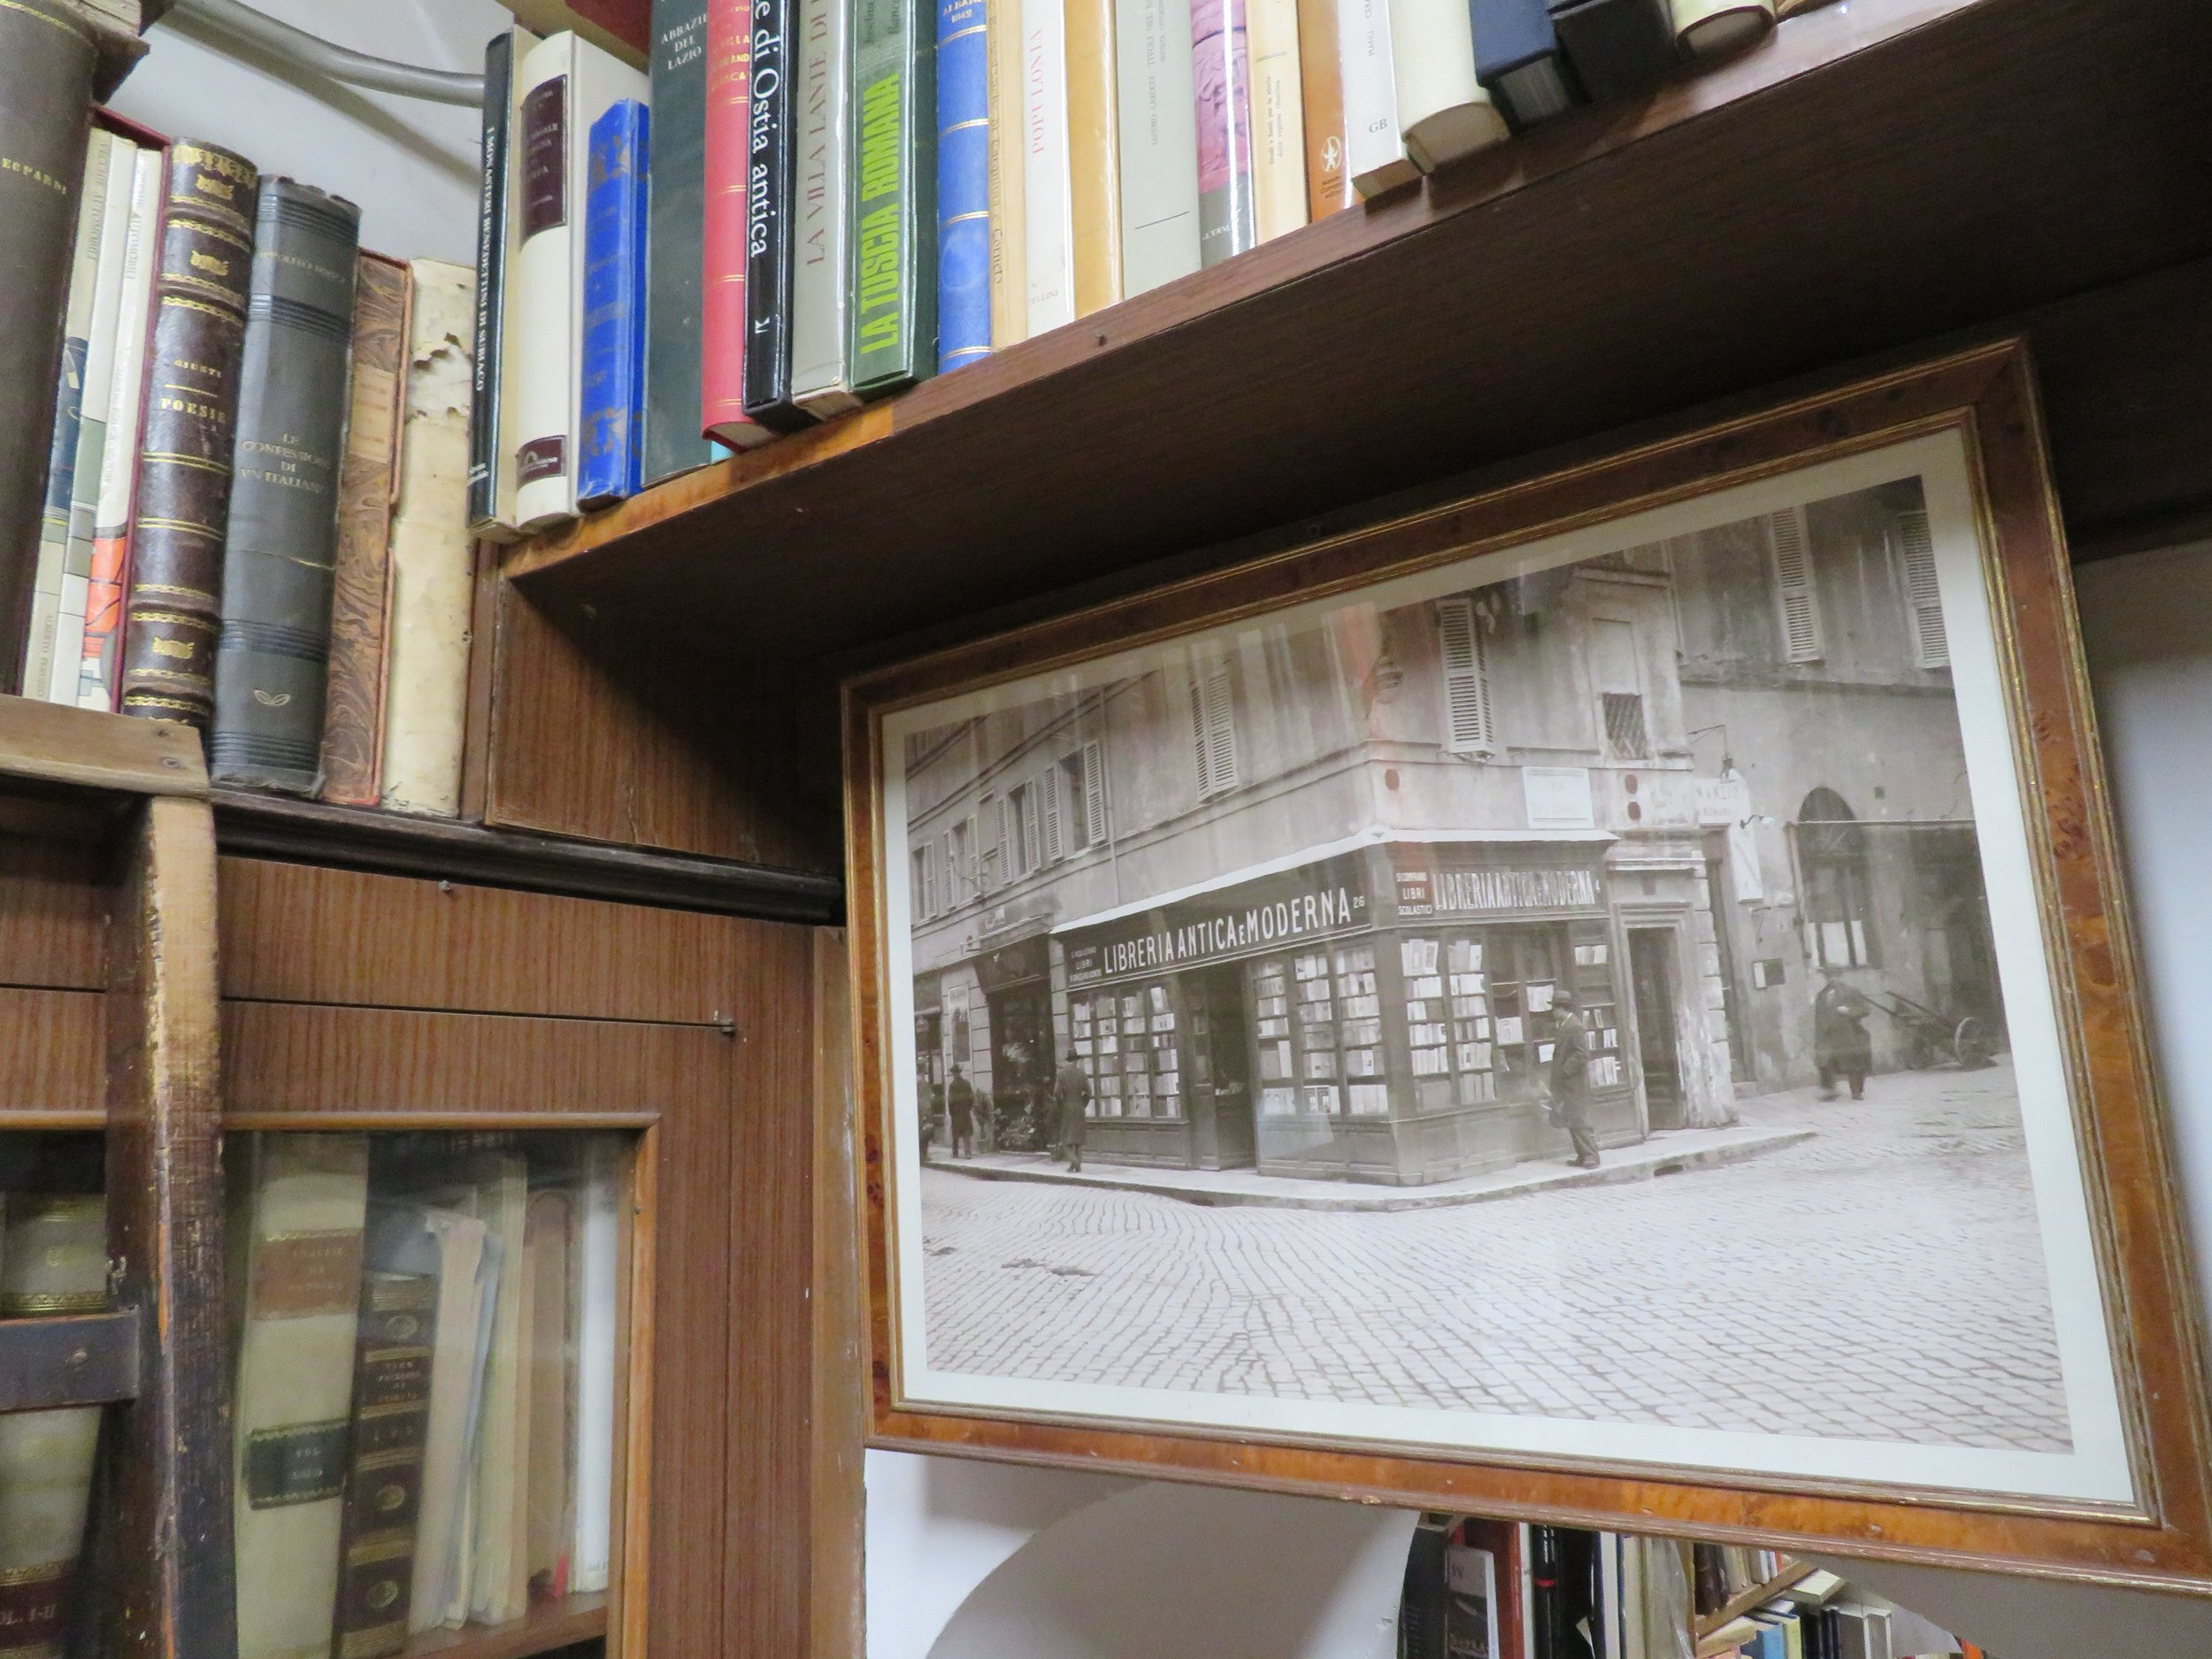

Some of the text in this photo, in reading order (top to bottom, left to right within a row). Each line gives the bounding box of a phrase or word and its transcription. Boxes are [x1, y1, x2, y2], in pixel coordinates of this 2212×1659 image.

[674, 35, 695, 52] DEL
[755, 29, 780, 62] di
[810, 13, 827, 42] DI
[667, 46, 702, 70] LAZIO
[753, 67, 780, 154] Ostia
[809, 50, 826, 135] LANTE
[1030, 29, 1044, 154] POPULONIA
[1368, 119, 1388, 134] GB
[484, 135, 495, 215] MONASTERI
[807, 145, 826, 220] VILLA
[751, 163, 776, 257] antica
[860, 73, 900, 354] LA TUSCIA ROMANA
[480, 216, 492, 307] BENEDETTINI
[807, 228, 826, 265] LA
[479, 311, 488, 326] DI
[475, 329, 487, 391] SUBIACO
[160, 396, 227, 424] POESIE
[280, 460, 297, 472] DI
[1402, 887, 1425, 900] LIBRI
[1433, 872, 1496, 910] LIBRERIA
[1103, 930, 1175, 973] LIBRERIA
[1177, 915, 1238, 958] ANTICA
[1247, 887, 1351, 941] MODERNA
[1353, 895, 1365, 909] 26
